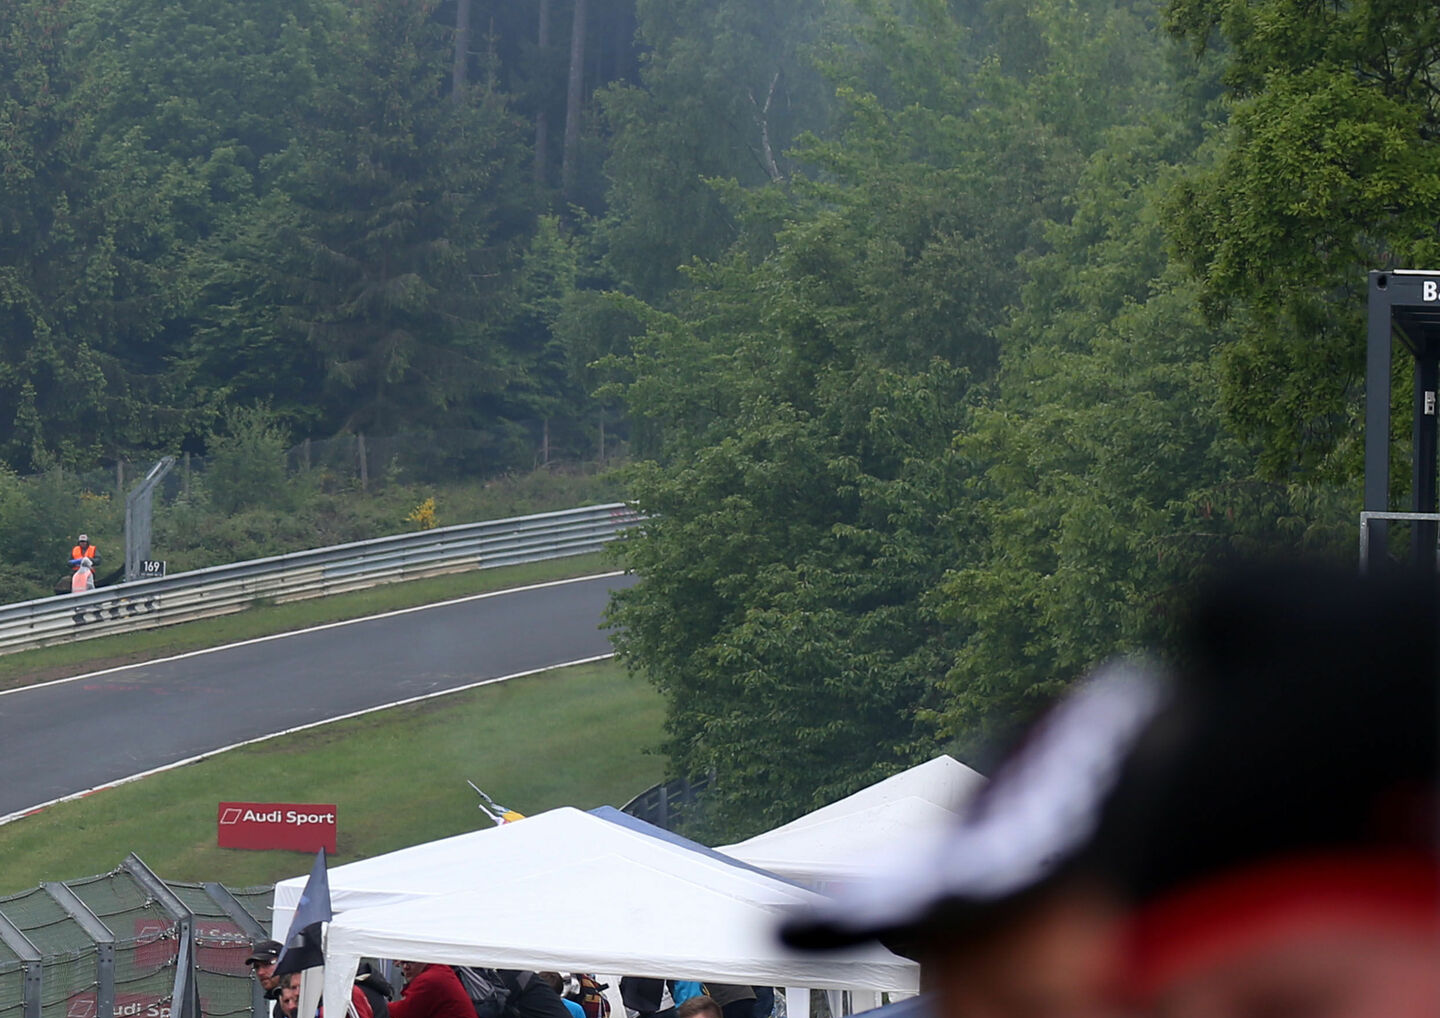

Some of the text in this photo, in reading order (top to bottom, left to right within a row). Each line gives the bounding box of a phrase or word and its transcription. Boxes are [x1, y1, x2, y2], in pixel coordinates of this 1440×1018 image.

[1423, 280, 1440, 301] B
[143, 560, 160, 572] 169
[242, 810, 335, 826] Audi Sport
